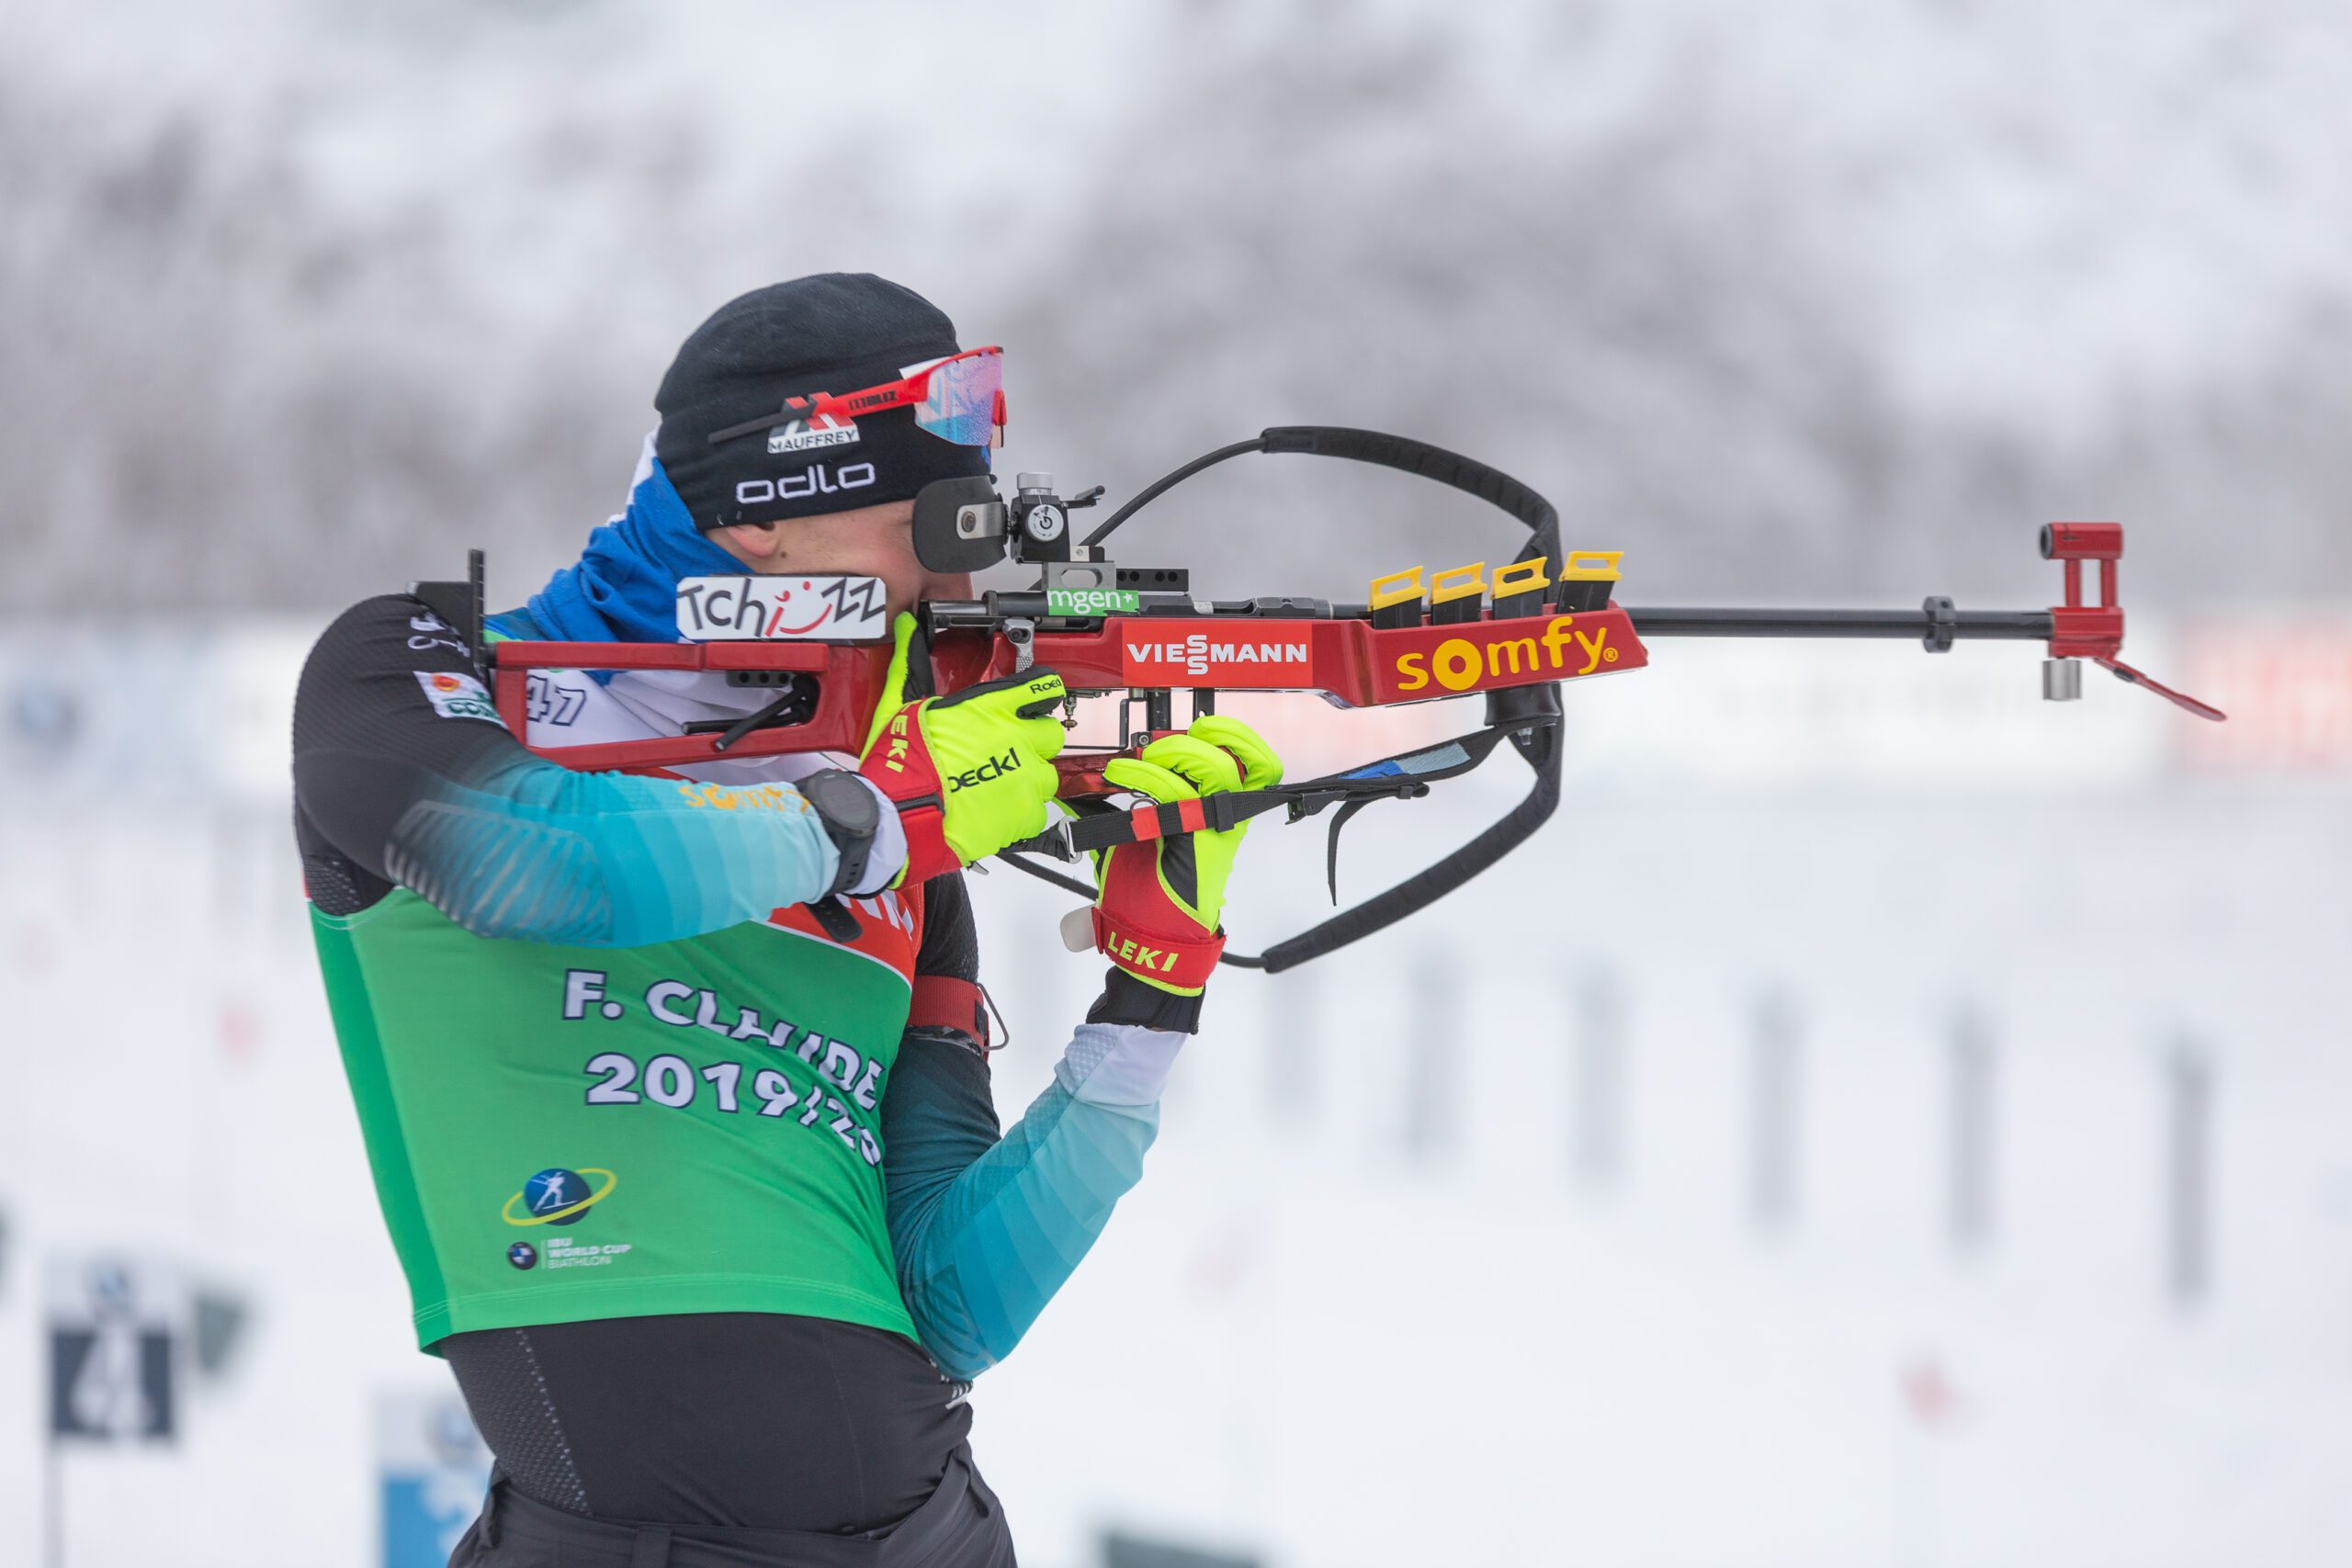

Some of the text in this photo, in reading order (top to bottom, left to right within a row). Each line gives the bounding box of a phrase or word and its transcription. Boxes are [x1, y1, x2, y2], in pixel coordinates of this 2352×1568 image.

[770, 429, 857, 452] MAUFFREY
[736, 462, 876, 504] odlo
[1126, 635, 1307, 675] VIESSMANN
[947, 747, 1022, 793] oeckl
[1108, 931, 1179, 973] LEKI
[561, 967, 624, 1021] F.
[548, 1244, 632, 1258] WORLD CUP
[548, 1256, 612, 1269] BIATHLON
